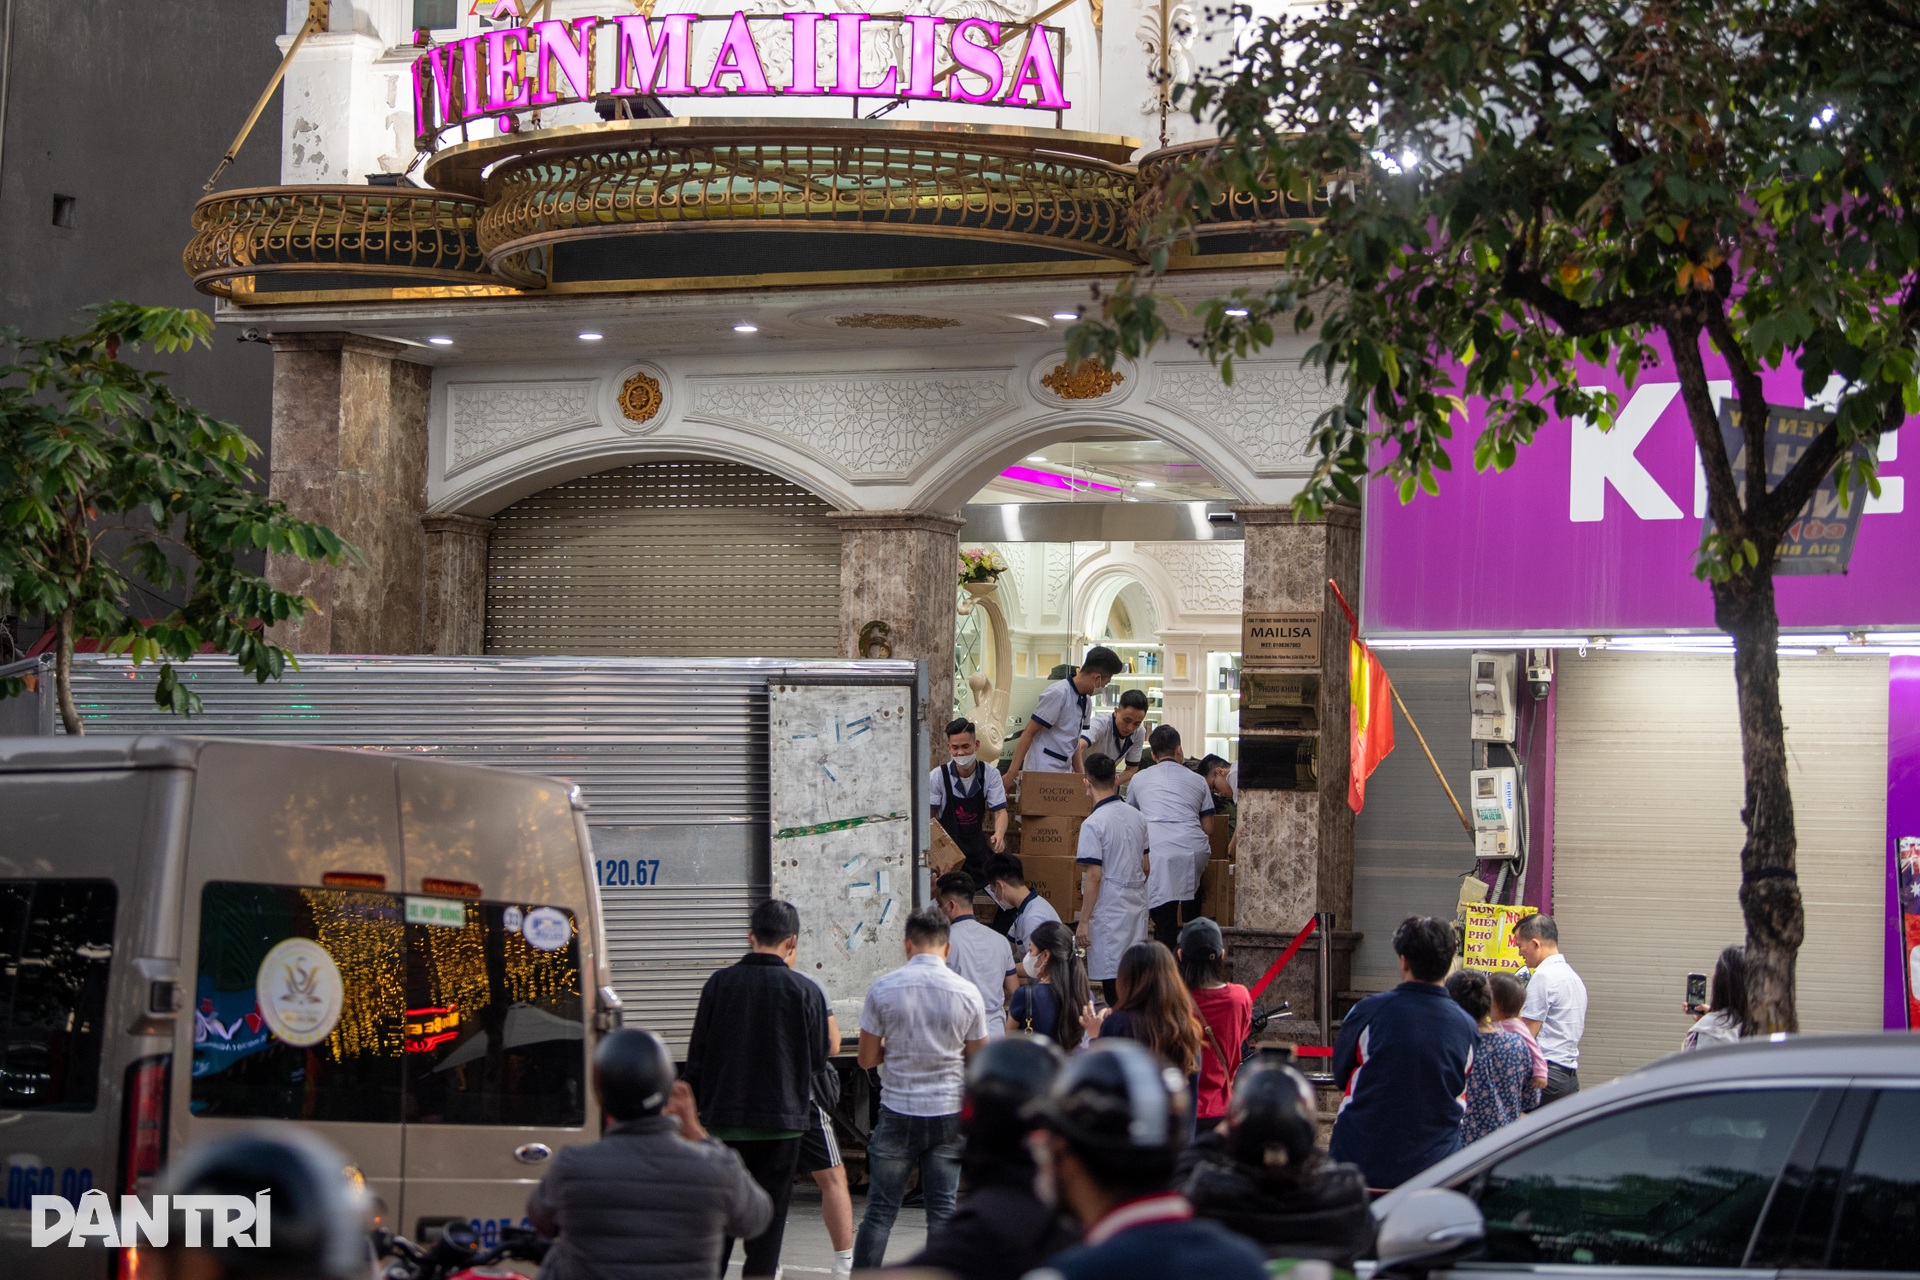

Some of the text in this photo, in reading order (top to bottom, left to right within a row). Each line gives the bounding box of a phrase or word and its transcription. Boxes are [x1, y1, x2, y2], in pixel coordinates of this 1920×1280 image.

[611, 10, 1071, 109] MAILISA
[1250, 627, 1312, 638] MAILISA
[1039, 787, 1074, 795] DOCTOR
[1043, 795, 1070, 803] MAGIC
[1035, 827, 1059, 835] MAGIC
[1030, 835, 1062, 843] DOCTOR
[596, 859, 660, 886] 120.67
[1500, 959, 1520, 968] ĐA
